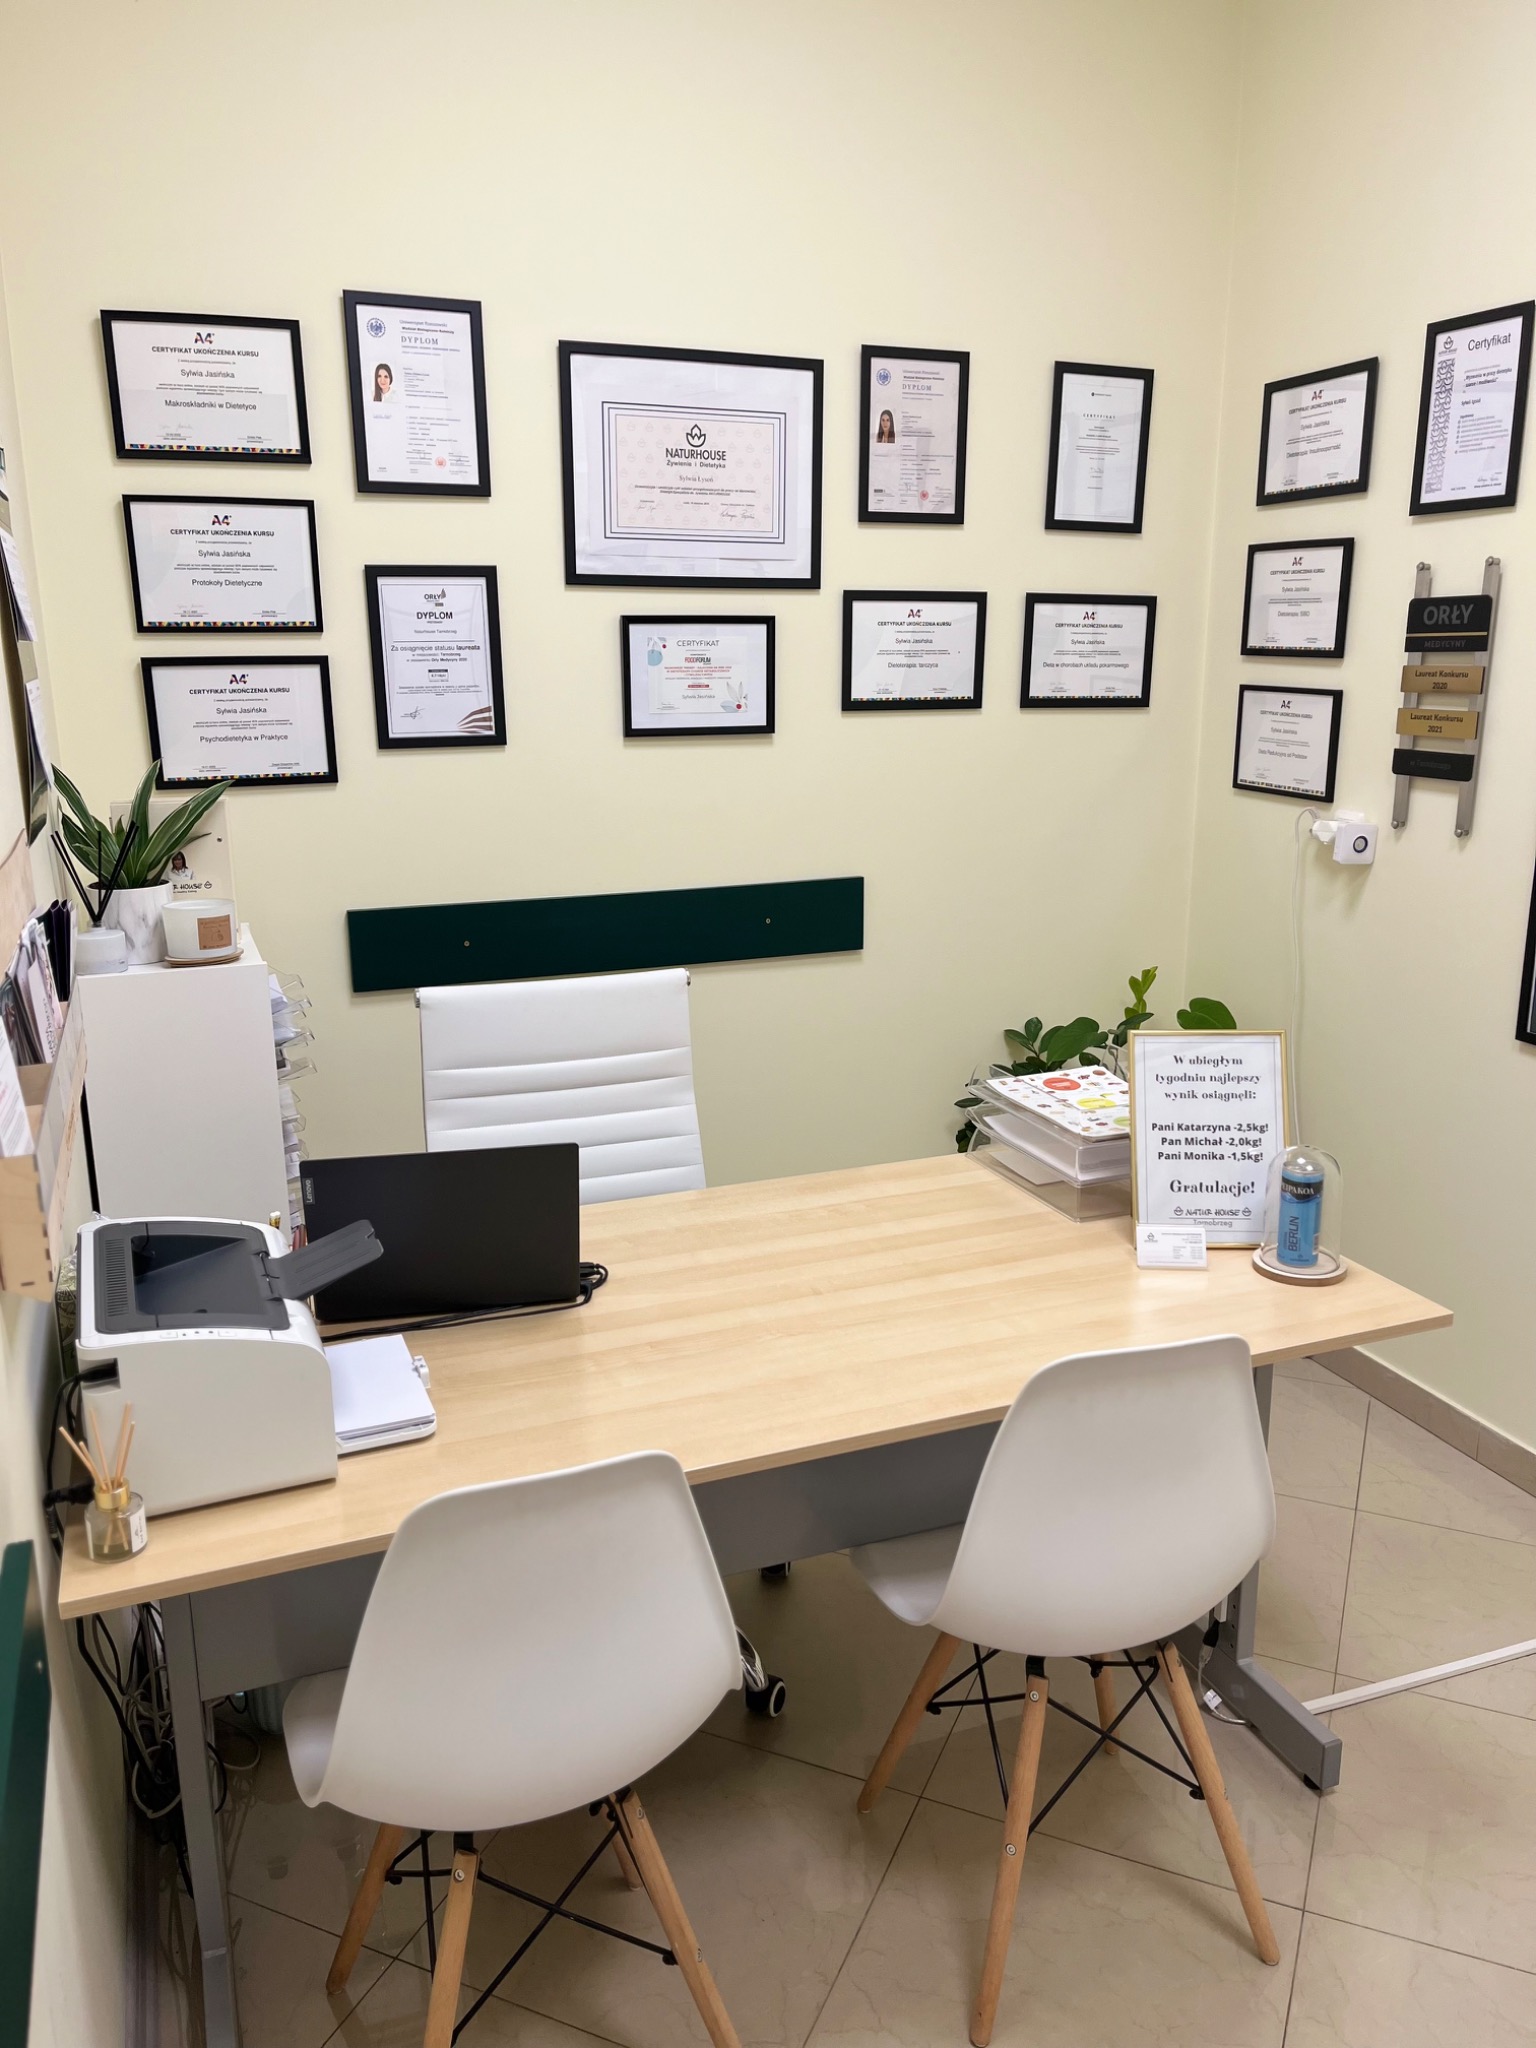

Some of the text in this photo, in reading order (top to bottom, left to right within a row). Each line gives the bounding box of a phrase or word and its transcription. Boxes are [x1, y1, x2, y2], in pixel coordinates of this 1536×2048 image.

[401, 336, 439, 345] DYPLOM
[1467, 332, 1512, 352] Certyfikat
[151, 346, 192, 354] CERTYFIKAT
[193, 347, 236, 356] UKOŃCZENIA
[180, 369, 235, 379] Sylwia Jasińska
[902, 383, 932, 391] DYPLOM
[164, 400, 217, 409] Makroskładniki
[225, 402, 257, 411] Dietetyce
[665, 448, 727, 461] NATURHOUSE
[666, 459, 692, 467] Żywienie
[699, 461, 726, 469] Dietetyka
[210, 528, 253, 536] UKOŃCZENIA
[198, 549, 251, 558] Sylwia Jasińska
[191, 578, 263, 587] Protokoły Dietetyczne
[416, 611, 453, 620] DYPLOM
[1423, 603, 1474, 625] ORŁY
[676, 639, 720, 647] CERTYFIKAT
[1424, 639, 1466, 648] MEDYCYNY
[1415, 670, 1469, 679] Laureat Konkursu
[1432, 682, 1448, 690] 2020
[216, 706, 267, 715] Sylwia Jasińska
[1410, 713, 1463, 723] Laureat Konkursu
[1427, 725, 1443, 733] 2021
[199, 735, 253, 744] Psychodietetyka
[1173, 1055, 1243, 1068] W ubiegłym
[1155, 1073, 1261, 1085] tygodniu najlepszy
[1164, 1090, 1257, 1102] wynik osiągnęli:
[1151, 1122, 1269, 1134] Pani Katarzyna -2,5kg!
[1161, 1137, 1262, 1148] Pan Michał -2,0kg!
[1157, 1151, 1264, 1163] Pani Monika -1,5kg!
[305, 1179, 313, 1203] Lenovo
[1169, 1179, 1255, 1198] Gratulacje!
[1185, 1208, 1241, 1217] NATUR HOUSE
[1287, 1215, 1300, 1252] BERLIN
